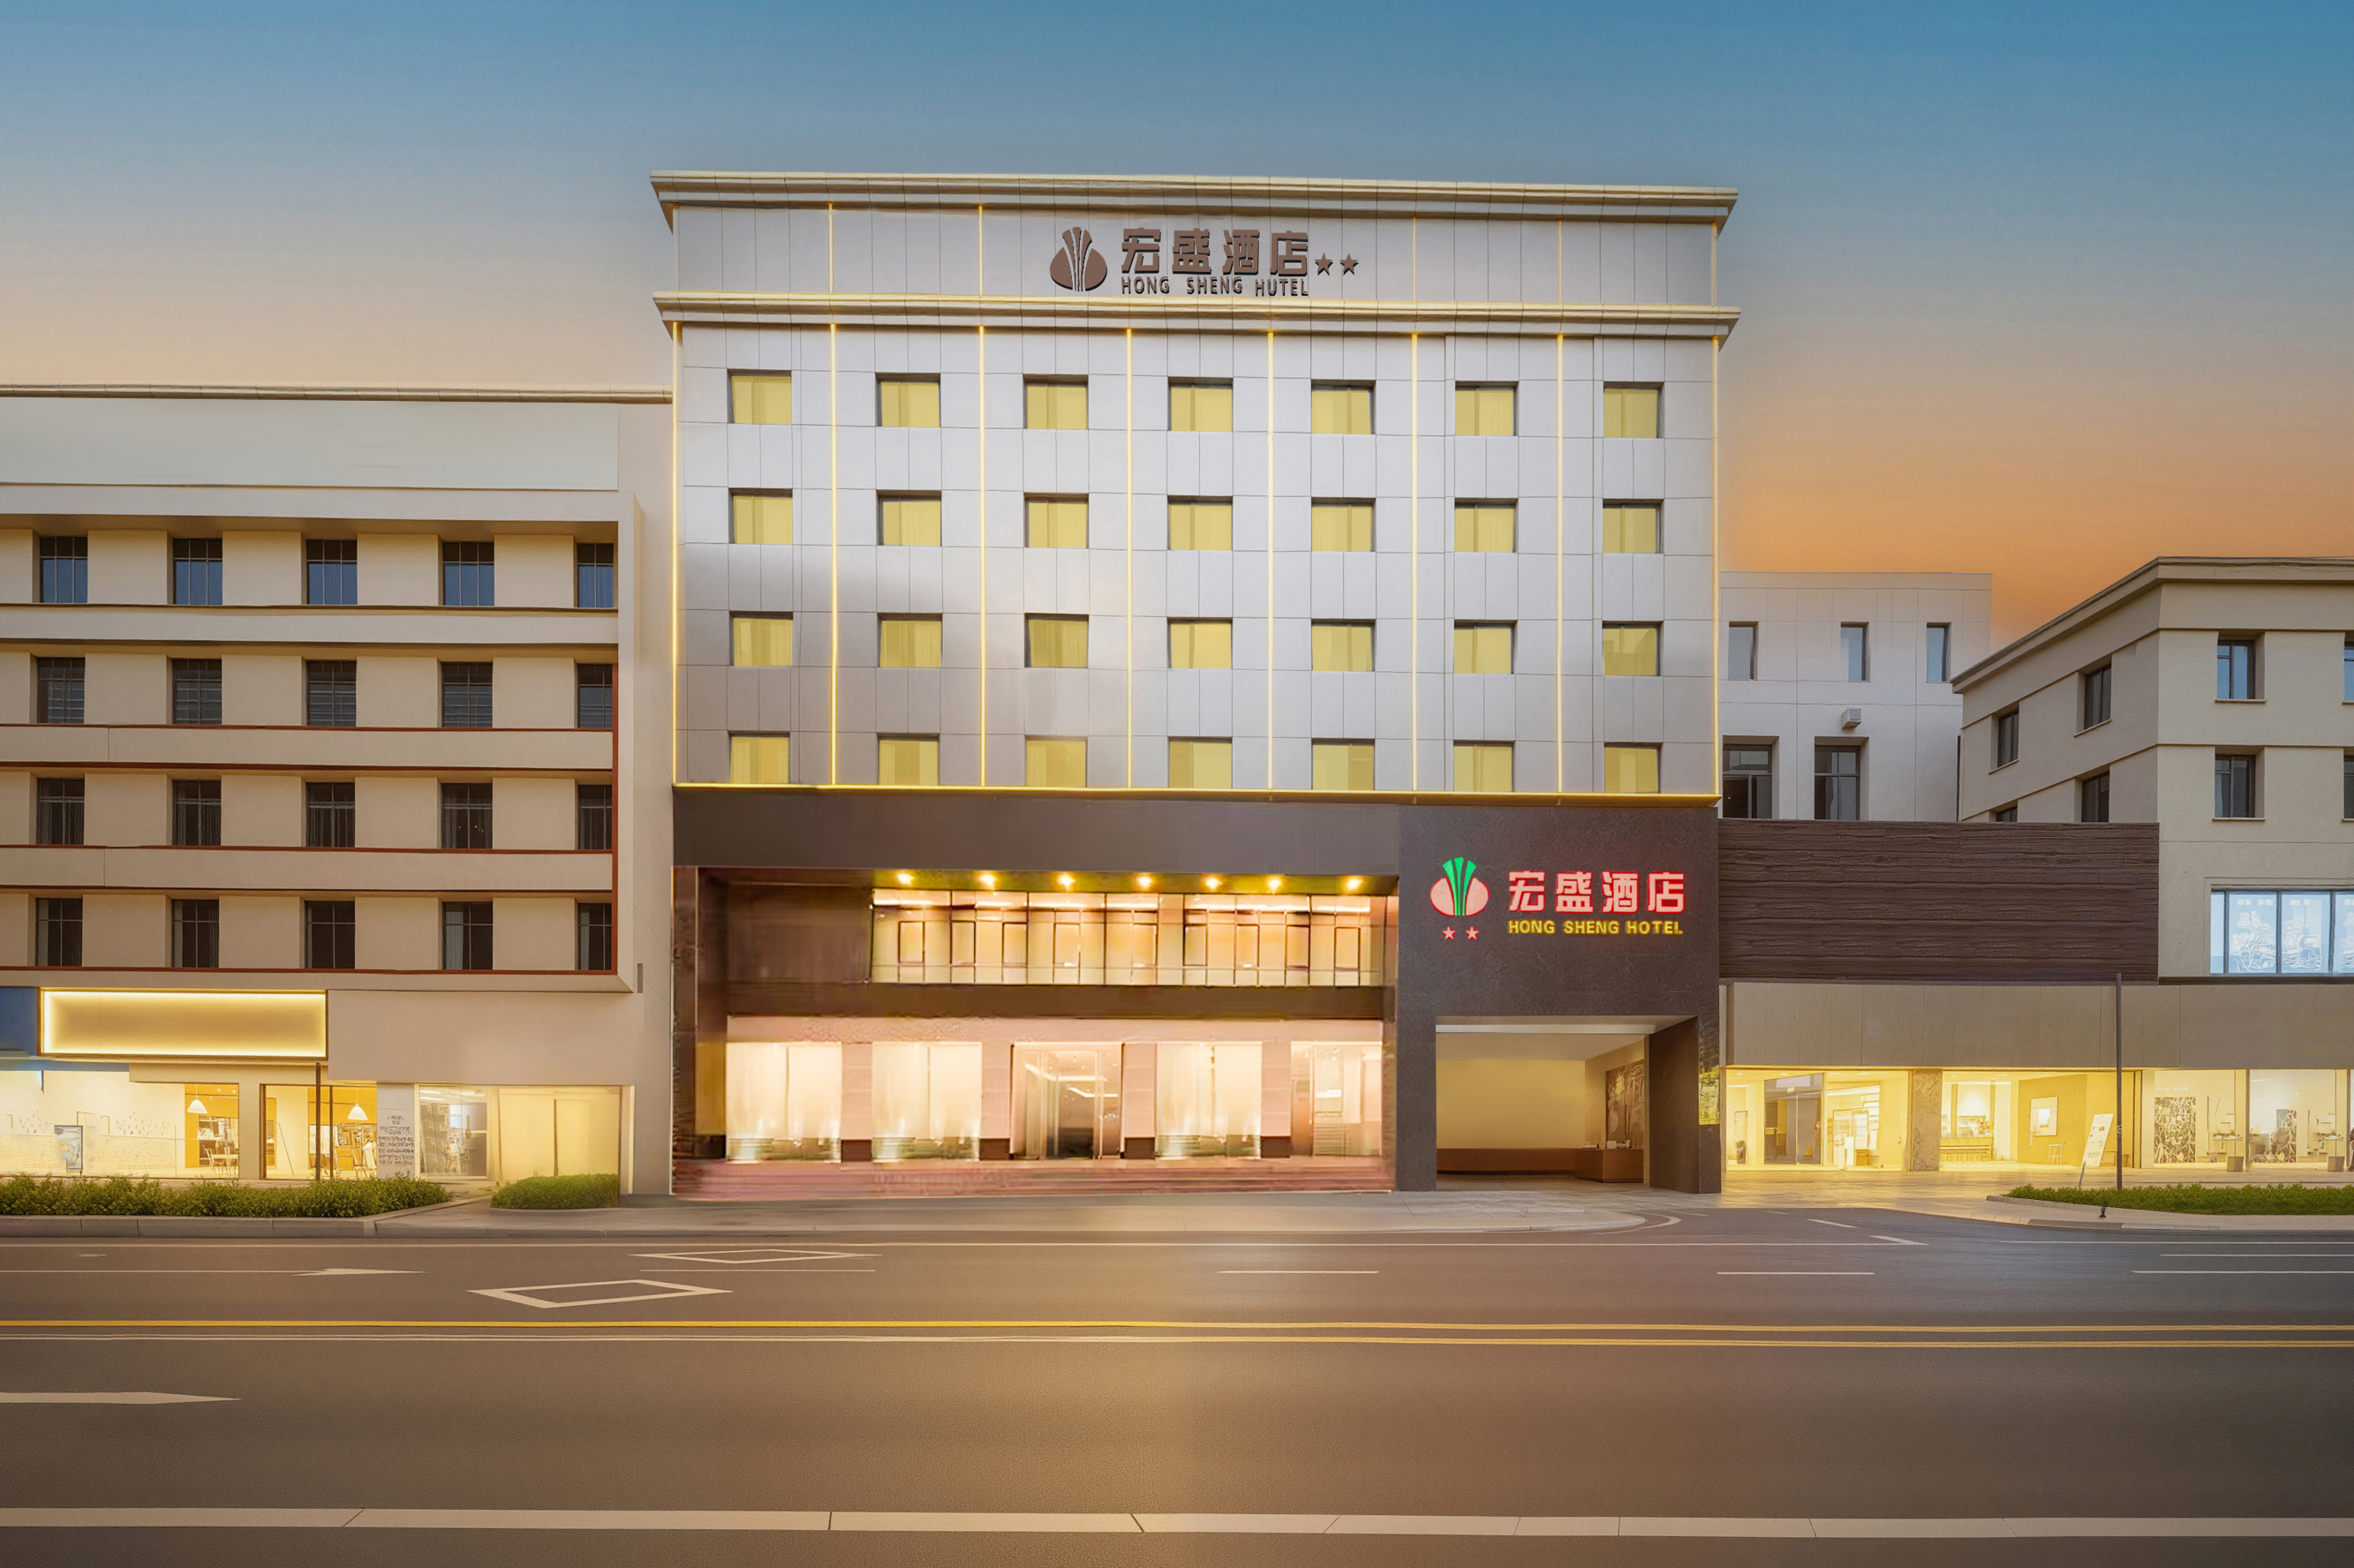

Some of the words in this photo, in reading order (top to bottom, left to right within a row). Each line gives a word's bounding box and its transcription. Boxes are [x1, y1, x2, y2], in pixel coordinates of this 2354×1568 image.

[1121, 227, 1309, 276] 宏盛酒店
[1121, 276, 1170, 294] HONG
[1187, 276, 1242, 294] SHENG
[1508, 870, 1686, 914] 宏盛酒店
[1508, 920, 1556, 935] HONG
[1563, 921, 1620, 935] SHENG
[1626, 921, 1684, 935] HOTEL
